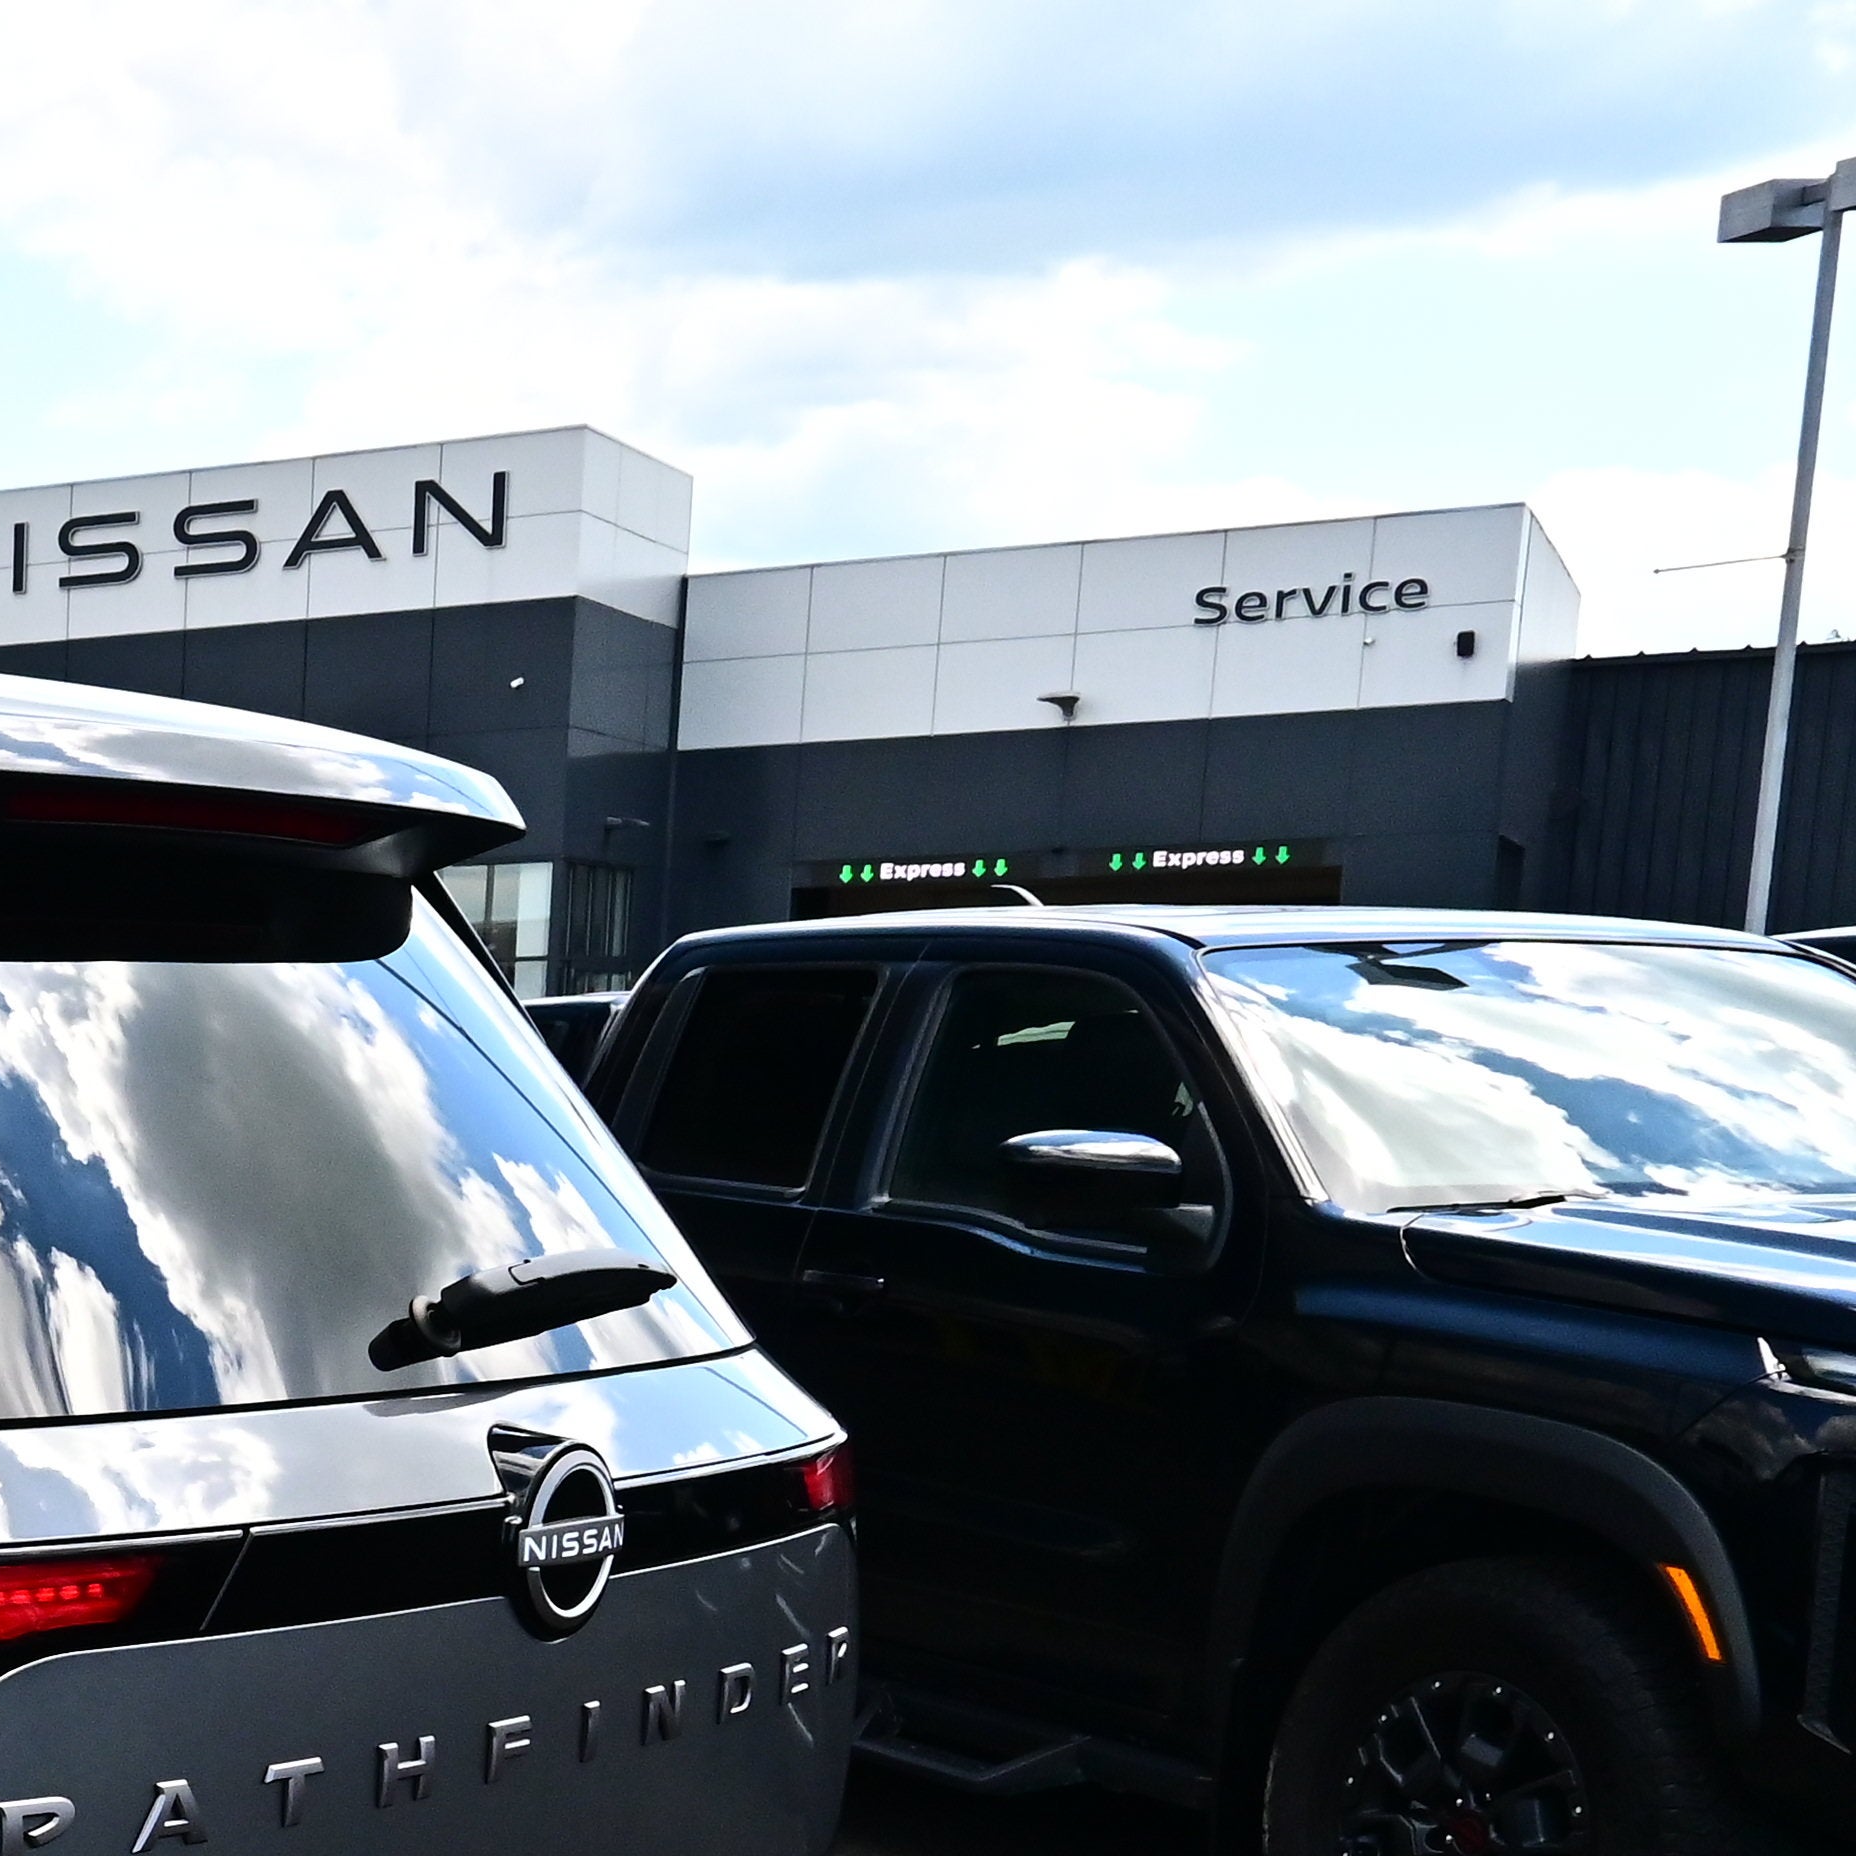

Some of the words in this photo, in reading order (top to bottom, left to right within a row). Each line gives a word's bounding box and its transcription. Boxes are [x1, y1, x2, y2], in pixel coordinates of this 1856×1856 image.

[1193, 572, 1430, 627] Service
[880, 861, 966, 881] Express
[1153, 848, 1245, 869] Express
[523, 1520, 625, 1562] NISSAN
